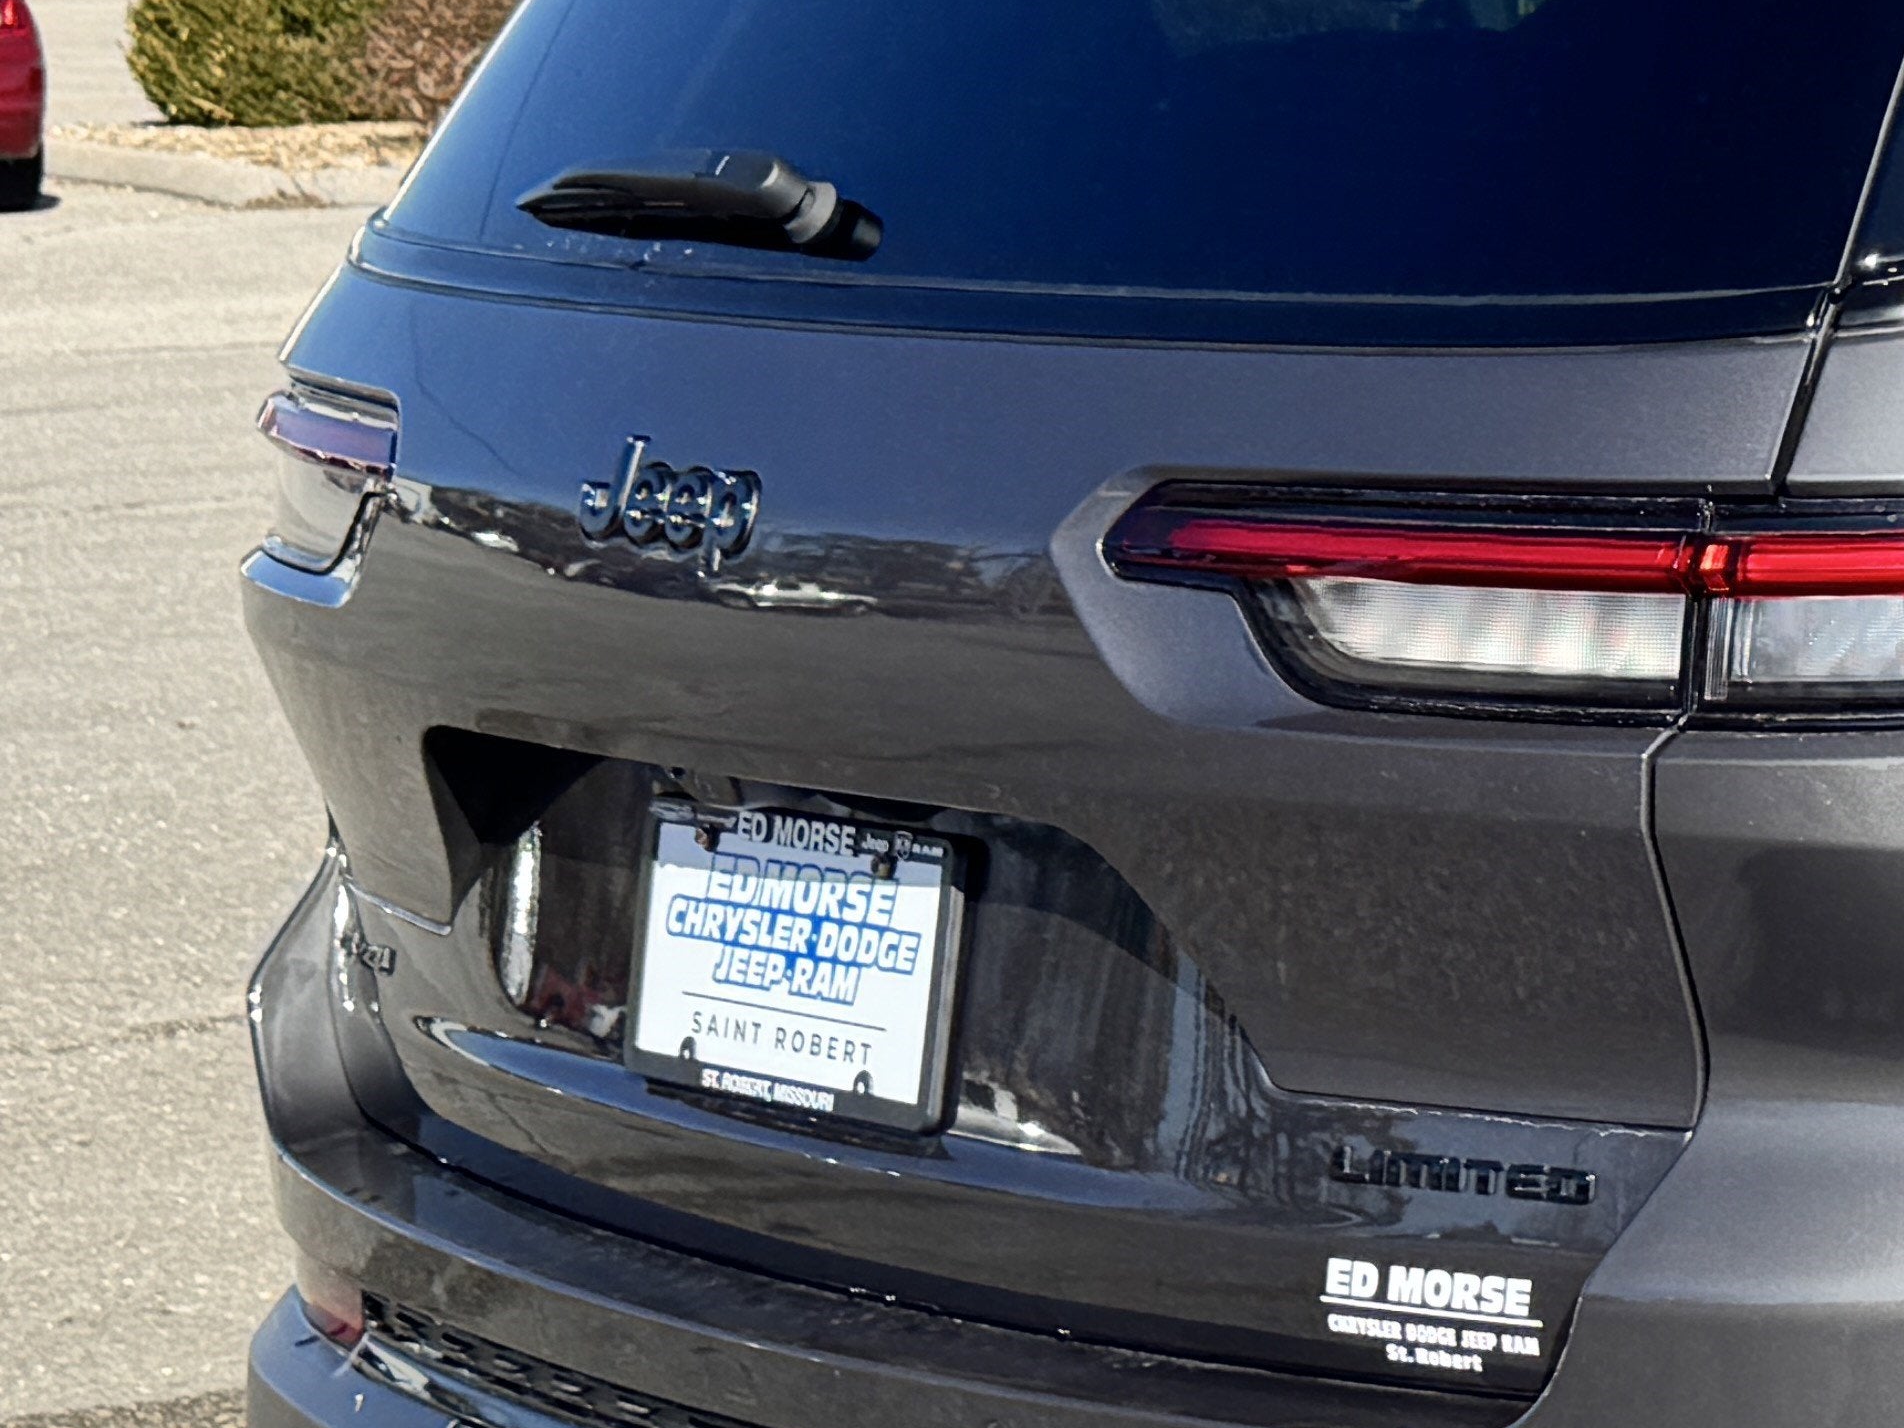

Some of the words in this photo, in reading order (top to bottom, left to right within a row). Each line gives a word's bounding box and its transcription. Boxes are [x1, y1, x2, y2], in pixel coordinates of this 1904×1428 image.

[579, 435, 762, 572] Jeep
[737, 811, 767, 843] ED
[772, 815, 857, 856] MORSE
[705, 851, 760, 905] ED
[757, 858, 899, 928] MORSE
[691, 1011, 762, 1045] SAINT
[773, 1027, 873, 1066] ROBERT
[1325, 1257, 1379, 1299] ED
[1386, 1264, 1533, 1317] MORSE
[1327, 1313, 1402, 1340] CHRYSLER
[1405, 1323, 1458, 1348] DODGE
[1460, 1329, 1498, 1352] JEEP
[1501, 1333, 1541, 1357] RAM
